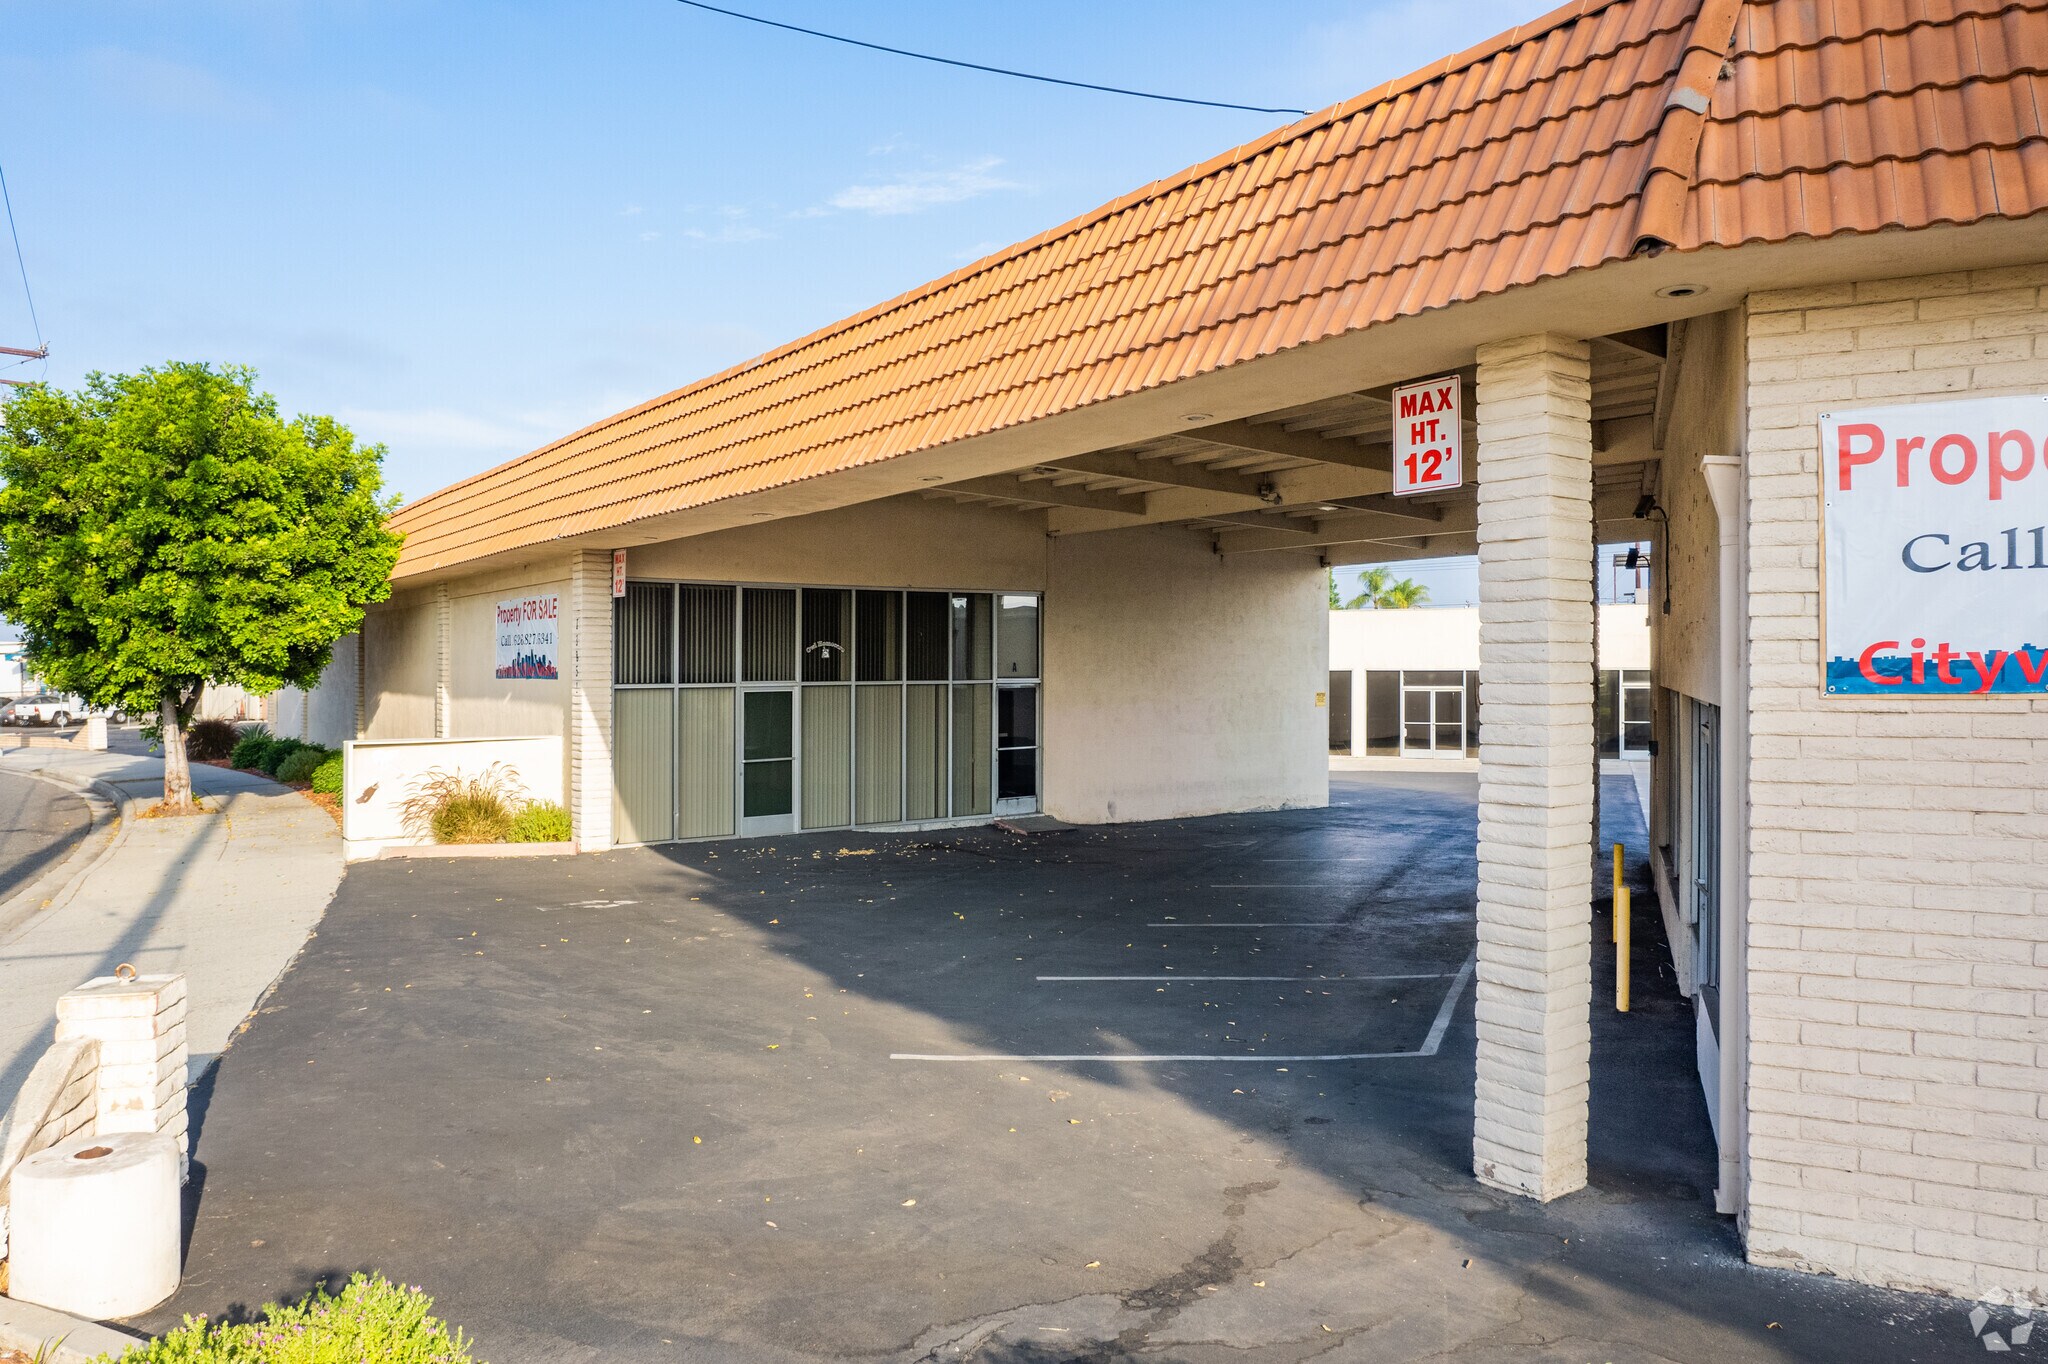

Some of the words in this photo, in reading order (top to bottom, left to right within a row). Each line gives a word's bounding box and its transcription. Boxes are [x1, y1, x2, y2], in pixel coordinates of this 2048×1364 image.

[1401, 386, 1453, 418] MAX
[1411, 419, 1446, 445] HT.
[1838, 423, 2048, 500] Prop
[1902, 526, 2048, 573] Call
[497, 605, 521, 627] Property
[523, 600, 537, 621] FOR
[538, 597, 557, 620] SALE
